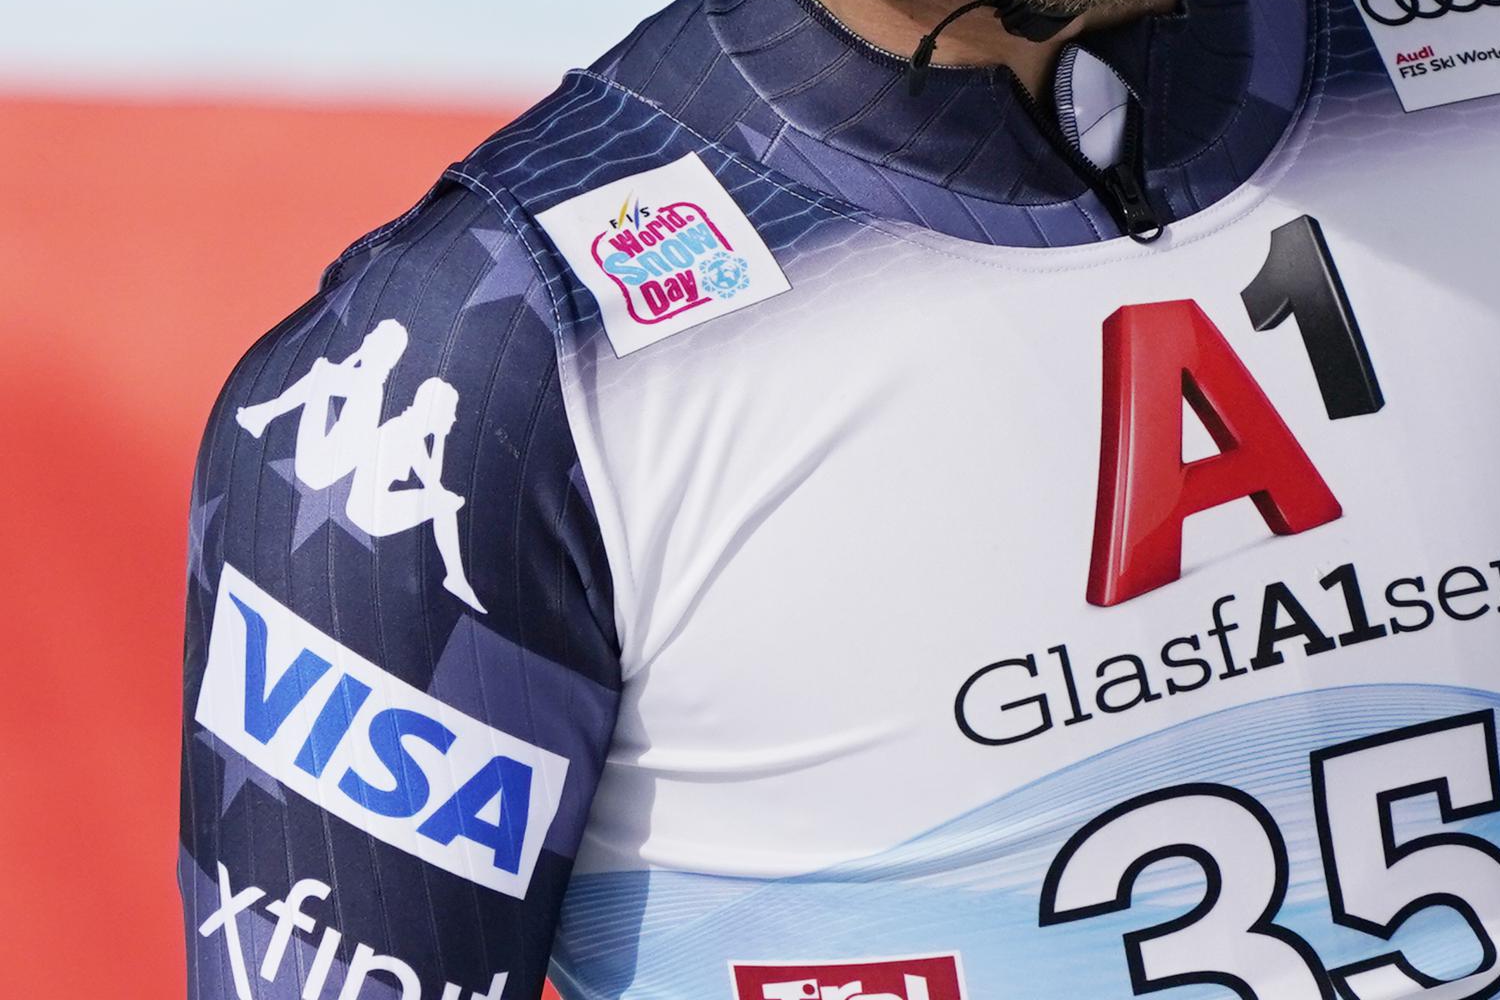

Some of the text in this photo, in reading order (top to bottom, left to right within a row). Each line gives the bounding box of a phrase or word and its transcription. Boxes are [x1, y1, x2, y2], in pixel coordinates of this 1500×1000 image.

[1395, 46, 1435, 64] Audi
[1399, 64, 1428, 79] FIS
[1430, 55, 1456, 73] Ski
[603, 222, 718, 285] Snow
[639, 269, 699, 316] Day
[1086, 214, 1386, 608] A1
[229, 592, 533, 876] VISA
[198, 860, 510, 1000] xfin
